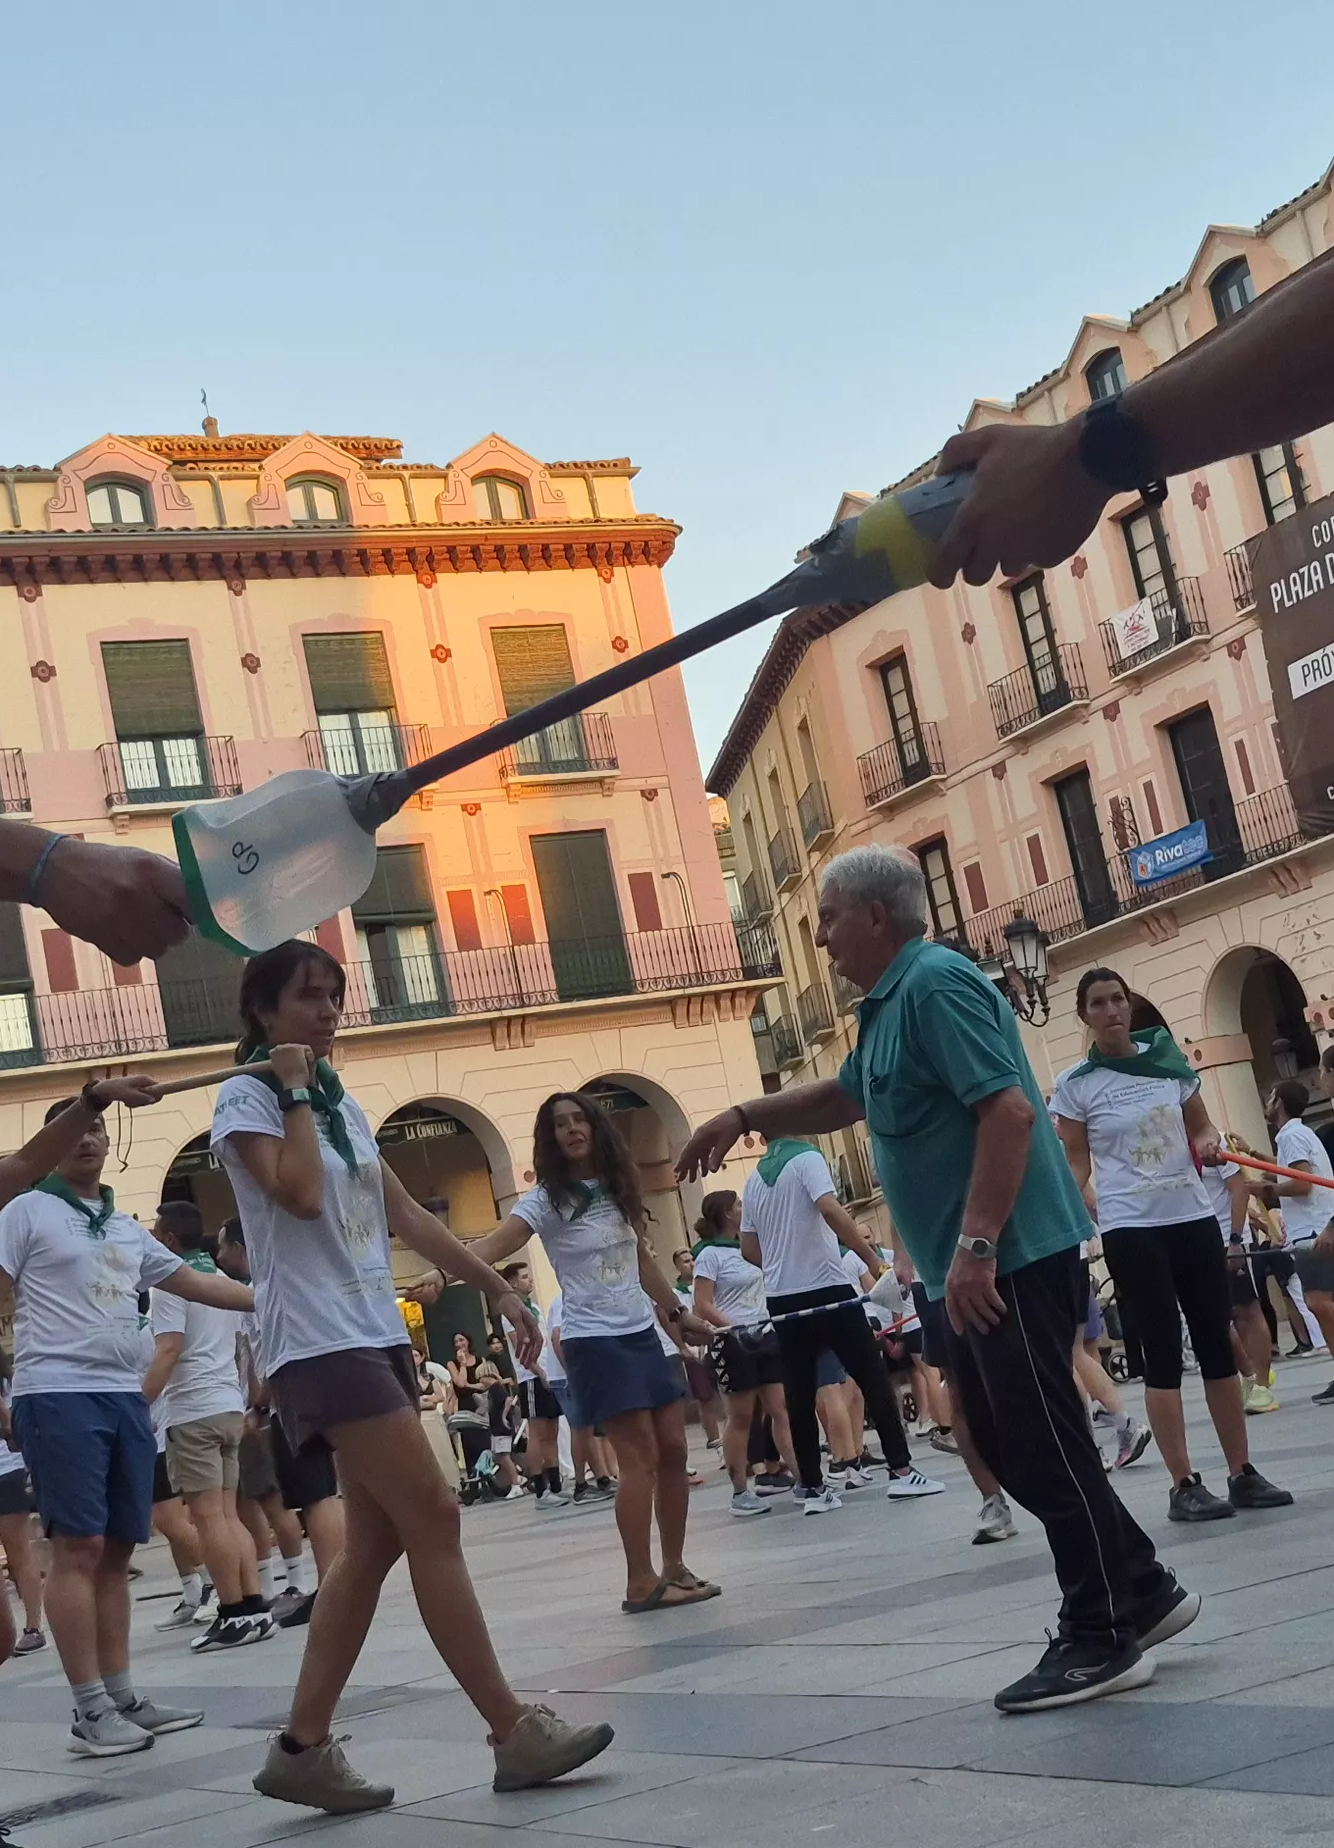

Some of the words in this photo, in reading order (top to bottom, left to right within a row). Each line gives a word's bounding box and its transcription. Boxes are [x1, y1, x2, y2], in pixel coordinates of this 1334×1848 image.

[1270, 560, 1325, 614] PLAZA
[405, 1125, 415, 1140] LA
[417, 1121, 457, 1138] CONFIANZA
